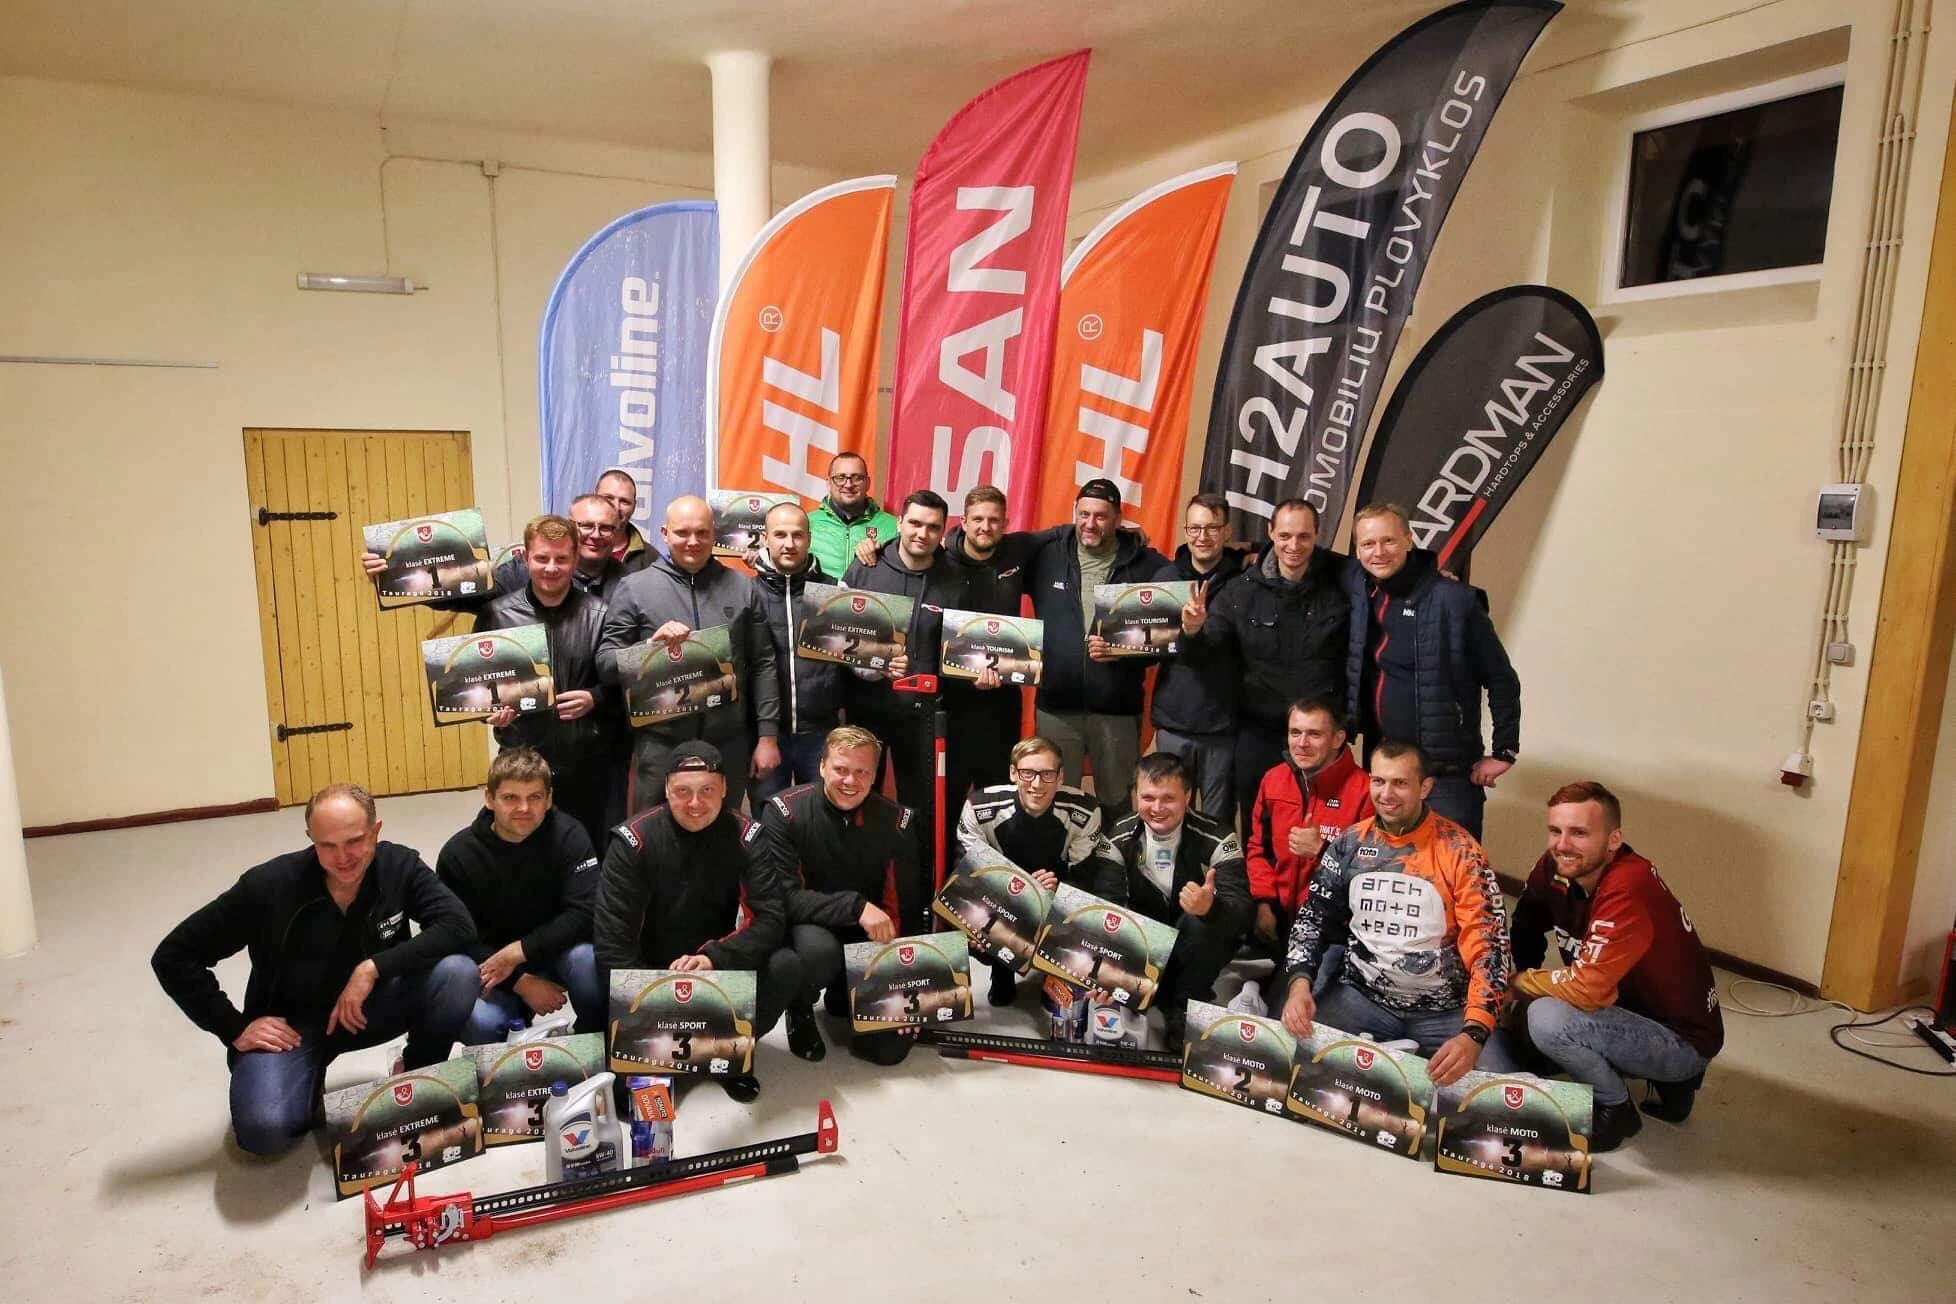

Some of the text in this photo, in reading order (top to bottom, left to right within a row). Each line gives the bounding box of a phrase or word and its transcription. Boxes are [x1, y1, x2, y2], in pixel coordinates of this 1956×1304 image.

[1364, 69, 1486, 316] PLOVYKLOS
[1225, 111, 1402, 520] H2AUTO
[1483, 357, 1591, 497] HARDTOPS & ACCESSORIES
[1407, 331, 1576, 550] ARDMAN
[747, 531, 761, 549] 2
[423, 553, 456, 566] EXTREME
[427, 567, 441, 589] 1
[1140, 617, 1169, 625] TOURISM
[847, 625, 877, 636] EXTREME
[986, 645, 1014, 654] TOURISM
[985, 653, 1000, 672] 2
[482, 669, 517, 681] EXTREME
[673, 670, 704, 684] EXTREME
[1361, 877, 1422, 897] arch
[996, 905, 1018, 923] SPORT
[1360, 898, 1421, 918] moto
[1360, 918, 1418, 938] team
[1099, 946, 1123, 961] SPORT
[907, 979, 931, 988] SPORT
[903, 991, 920, 1014] 3
[679, 1021, 708, 1030] SPORT
[671, 1032, 692, 1061] 3
[669, 1061, 699, 1073] 2018
[1242, 1058, 1266, 1071] MOTO
[1233, 1066, 1252, 1093] 2
[527, 1086, 554, 1098] EXTRE
[1355, 1086, 1382, 1101] MOTO
[399, 1115, 440, 1134] EXTREME
[1510, 1128, 1539, 1139] MOTO
[399, 1135, 422, 1163] 3
[1501, 1137, 1523, 1168] 3
[1498, 1166, 1530, 1182] 2018
